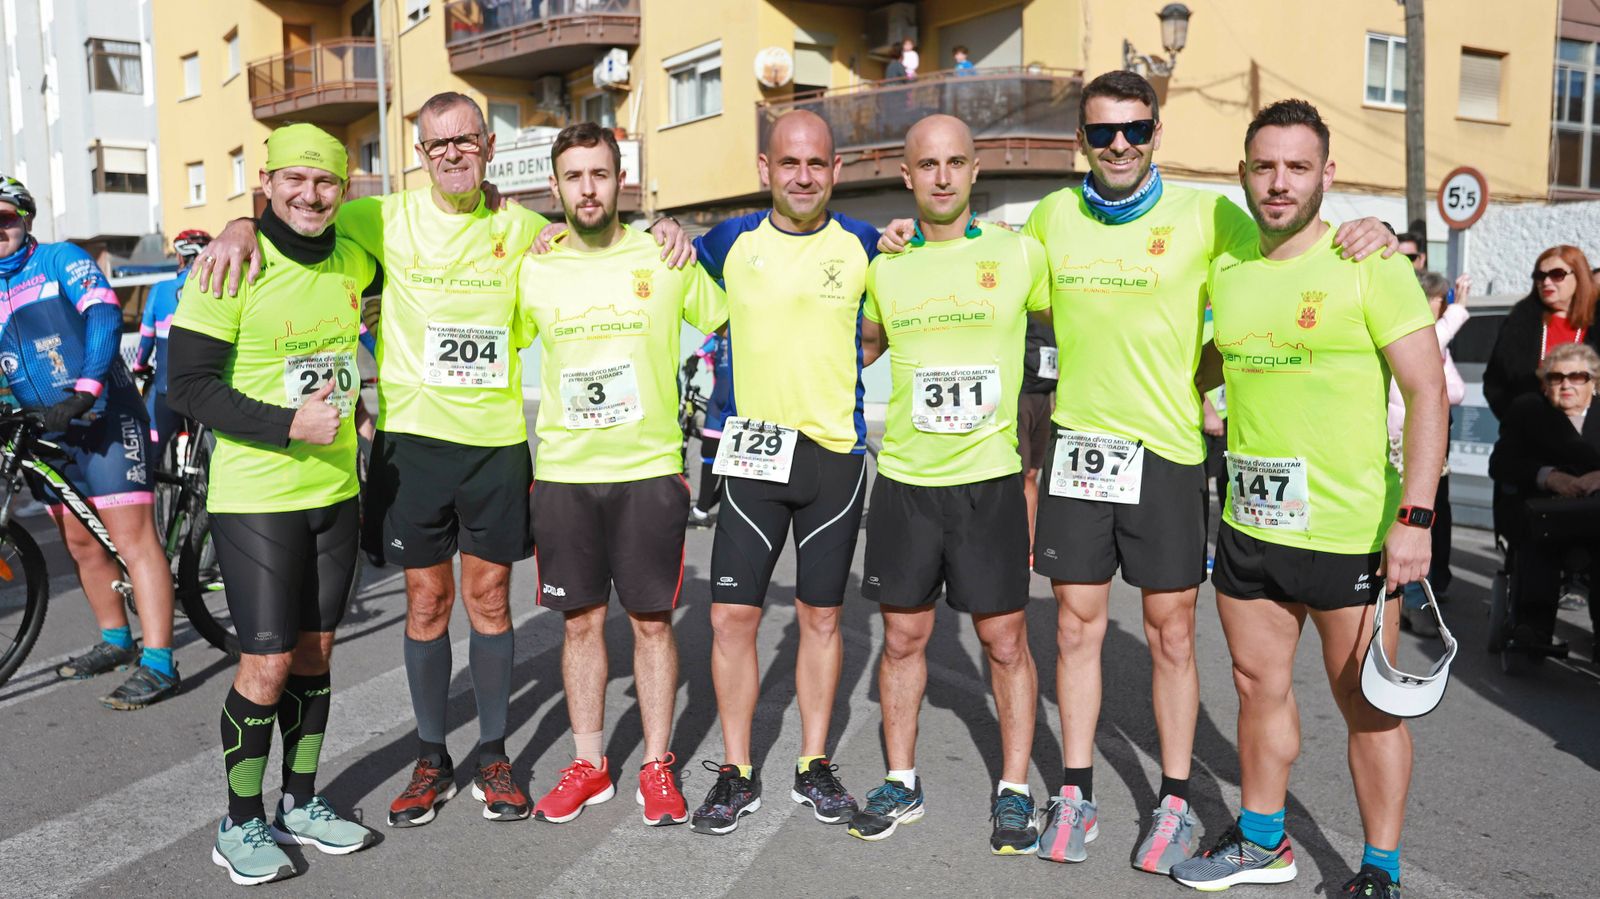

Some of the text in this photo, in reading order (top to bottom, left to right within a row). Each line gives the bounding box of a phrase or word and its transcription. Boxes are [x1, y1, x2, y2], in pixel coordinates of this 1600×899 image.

[411, 274, 502, 288] San roque
[1058, 274, 1148, 287] San roque
[554, 322, 643, 336] San roque
[892, 312, 986, 329] San roque
[285, 334, 356, 351] San roque
[438, 340, 497, 363] 204
[1245, 356, 1302, 367] roque
[300, 369, 352, 395] 210
[596, 371, 623, 381] CIUDADES
[587, 382, 606, 404] 3
[925, 382, 982, 407] 311
[732, 432, 782, 456] 129
[1068, 448, 1127, 475] 197
[1234, 472, 1289, 502] 147
